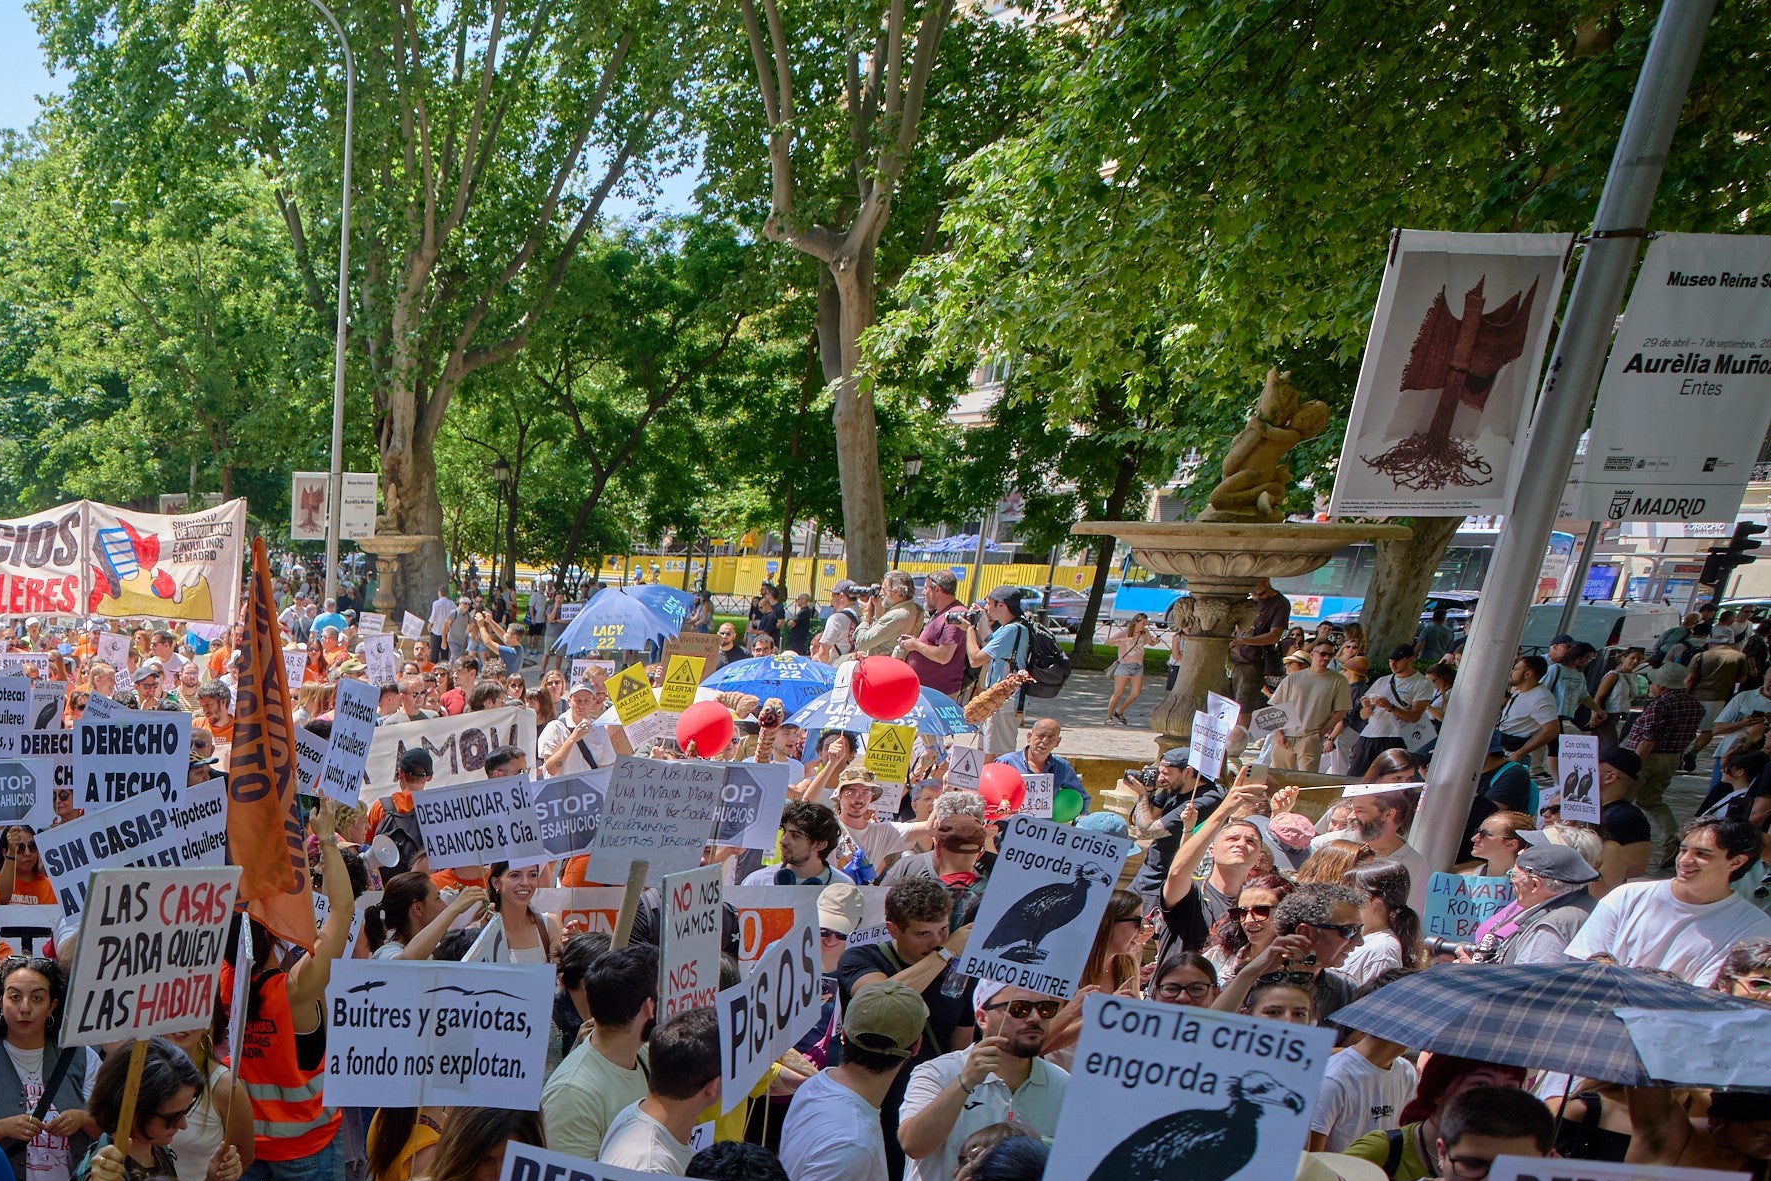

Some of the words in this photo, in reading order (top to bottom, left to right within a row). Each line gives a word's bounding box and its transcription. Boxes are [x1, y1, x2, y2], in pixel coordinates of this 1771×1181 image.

[1666, 271, 1716, 286] Museo
[1720, 272, 1758, 288] Reina
[1623, 353, 1711, 373] Aurèlia
[1680, 379, 1722, 395] Entes
[1632, 498, 1705, 518] MADRID
[179, 538, 224, 552] INQUILINOS
[173, 554, 183, 563] DE
[596, 637, 616, 649] 22
[779, 671, 801, 679] 22
[664, 685, 695, 693] ¡ALERTA!
[1257, 712, 1282, 723] STOP
[1564, 740, 1576, 749] Con
[1576, 742, 1592, 750] crisis,
[868, 752, 905, 762] ¡ALERTA!
[1561, 752, 1596, 760] engordamos.
[416, 791, 510, 825] DESAHUCIAR,
[512, 780, 531, 810] SÍ:
[535, 792, 597, 821] STOP
[610, 801, 625, 815] NO
[428, 836, 436, 857] A
[436, 830, 494, 856] BANCOS
[497, 827, 508, 847] &
[511, 821, 538, 844] Cía.
[100, 881, 151, 927] LAS
[159, 882, 233, 928] CASAS
[96, 929, 164, 982] PARA
[77, 988, 135, 1034] LAS
[730, 926, 821, 1081] PiS.O.S.
[332, 997, 413, 1031] Buitres
[416, 1005, 432, 1034] y
[434, 1005, 533, 1039] gaviotas,
[1097, 999, 1164, 1045] Con
[1170, 1012, 1203, 1048] la
[1210, 1020, 1315, 1072] crisis,
[330, 1055, 342, 1077] a
[346, 1047, 400, 1078] fondo
[404, 1055, 435, 1078] nos
[439, 1048, 527, 1085] explotan.
[1084, 1045, 1220, 1098] engorda
